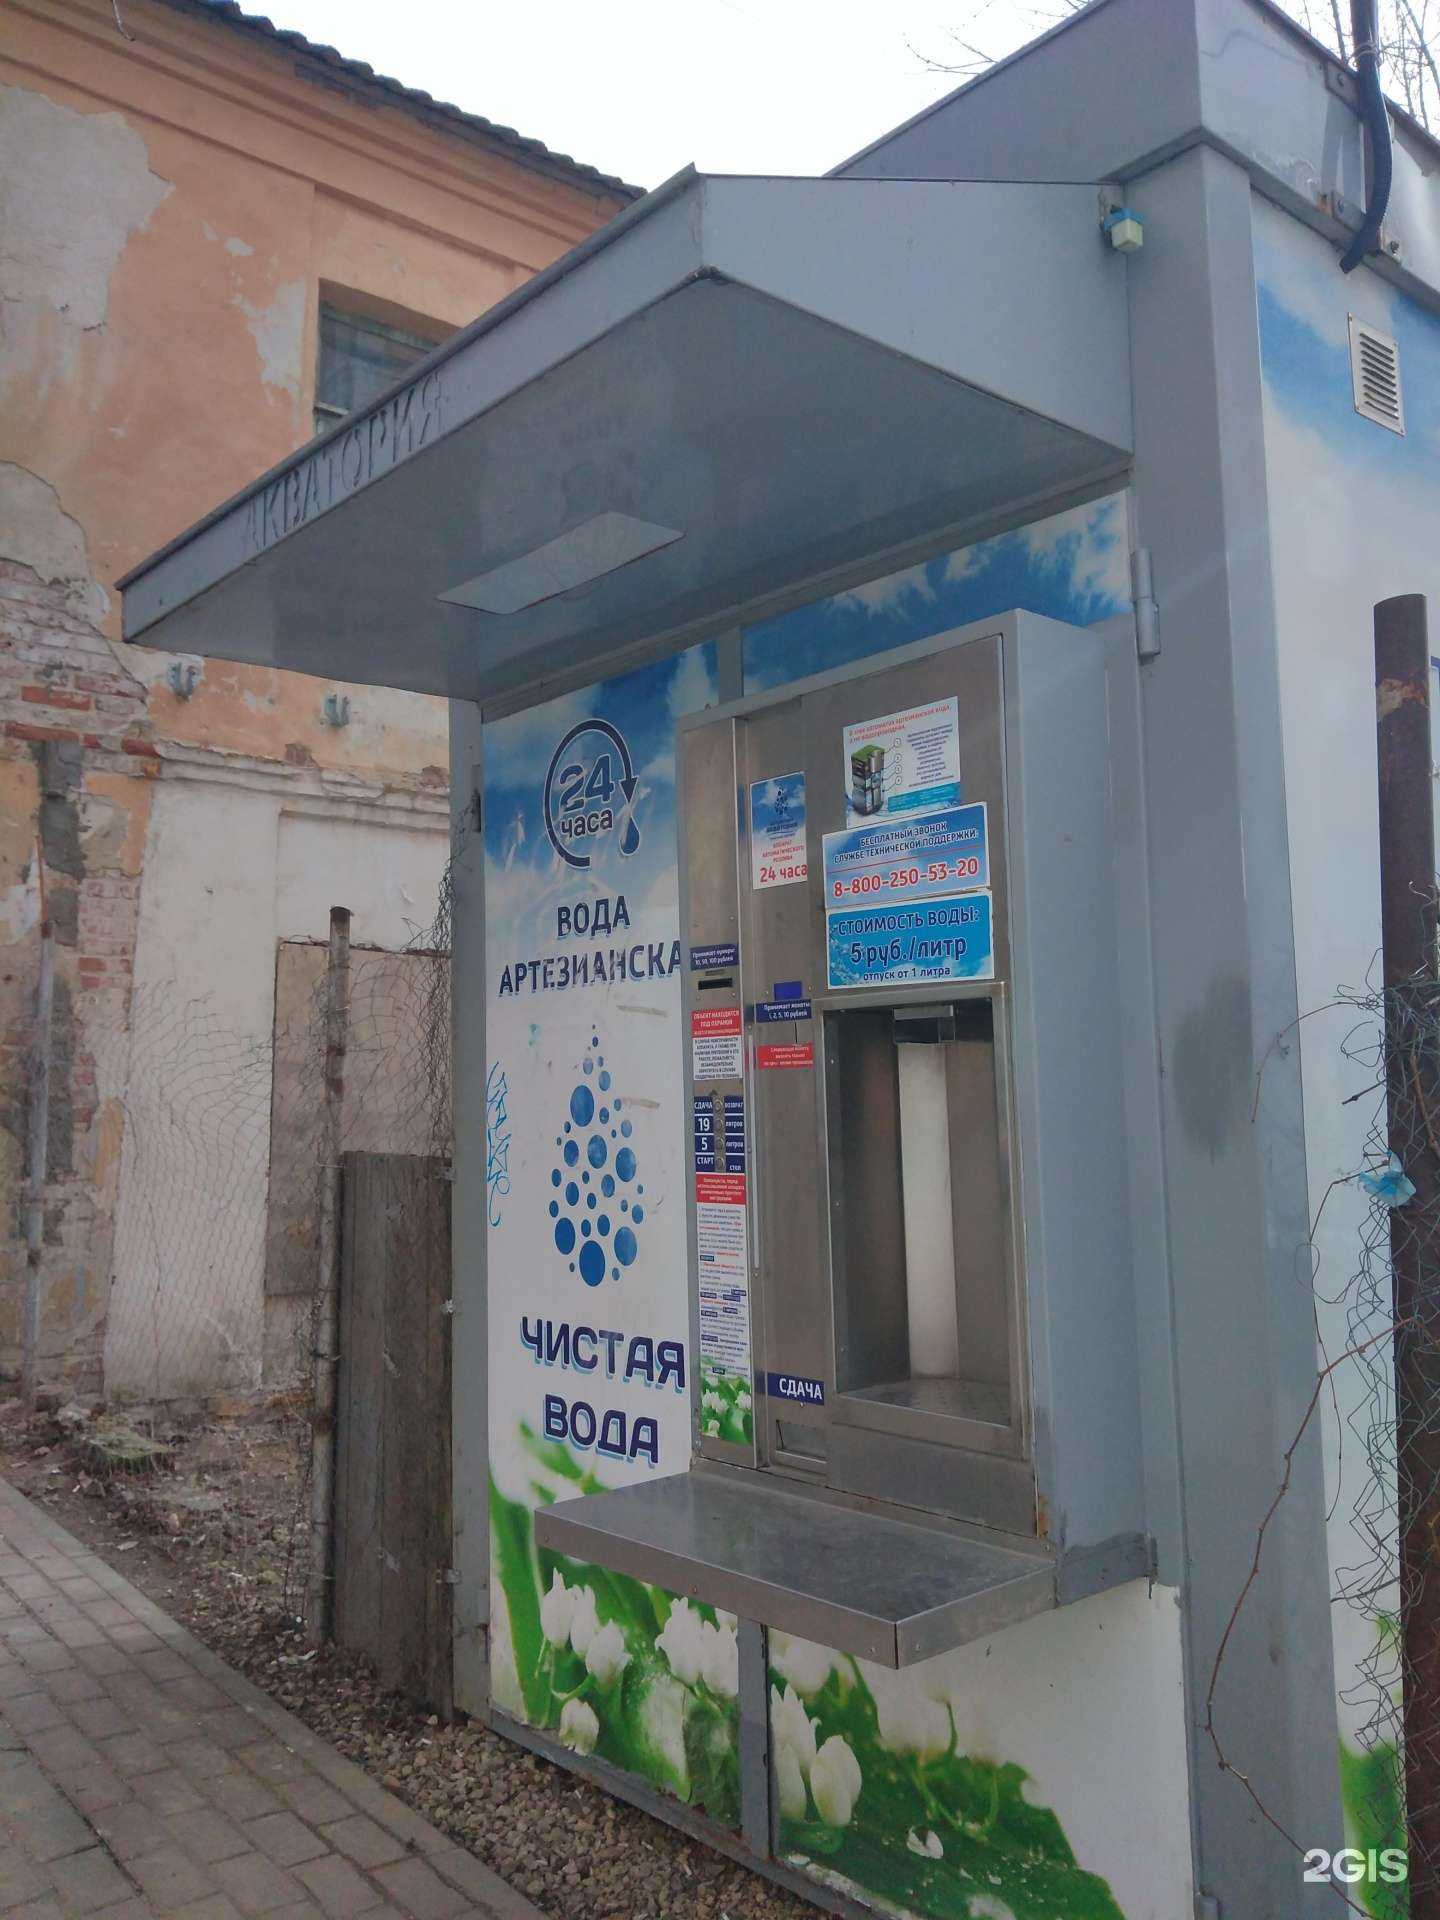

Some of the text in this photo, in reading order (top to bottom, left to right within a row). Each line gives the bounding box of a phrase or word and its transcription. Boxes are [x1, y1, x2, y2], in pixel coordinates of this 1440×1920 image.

[559, 754, 615, 813] 24
[560, 807, 614, 840] часа
[860, 821, 947, 848] БЕСПЛАТНЫЙ ЗВОНОК
[834, 829, 977, 864] СЛУЖБЕ ТЕХНИЧЕСКОЙ ПОДДЕРЖКИ
[759, 864, 808, 883] 24 часа
[834, 857, 979, 898] 8-800-250-53-20
[557, 896, 631, 939] ВОДА
[837, 907, 980, 936] СТОИМОСТЬ ВОДЫ:
[850, 937, 967, 968] 5 руб./литр
[863, 967, 951, 982] отпуск от 1 литра
[694, 1101, 713, 1110] СДАЧА
[698, 1117, 743, 1132] 19 литров
[701, 1136, 743, 1151] 5 литров
[697, 1156, 714, 1165] СТАРТ
[521, 1316, 687, 1391] ЧИСТАЯ
[778, 1377, 823, 1400] СДАЧА
[544, 1394, 659, 1466] ВОДА
